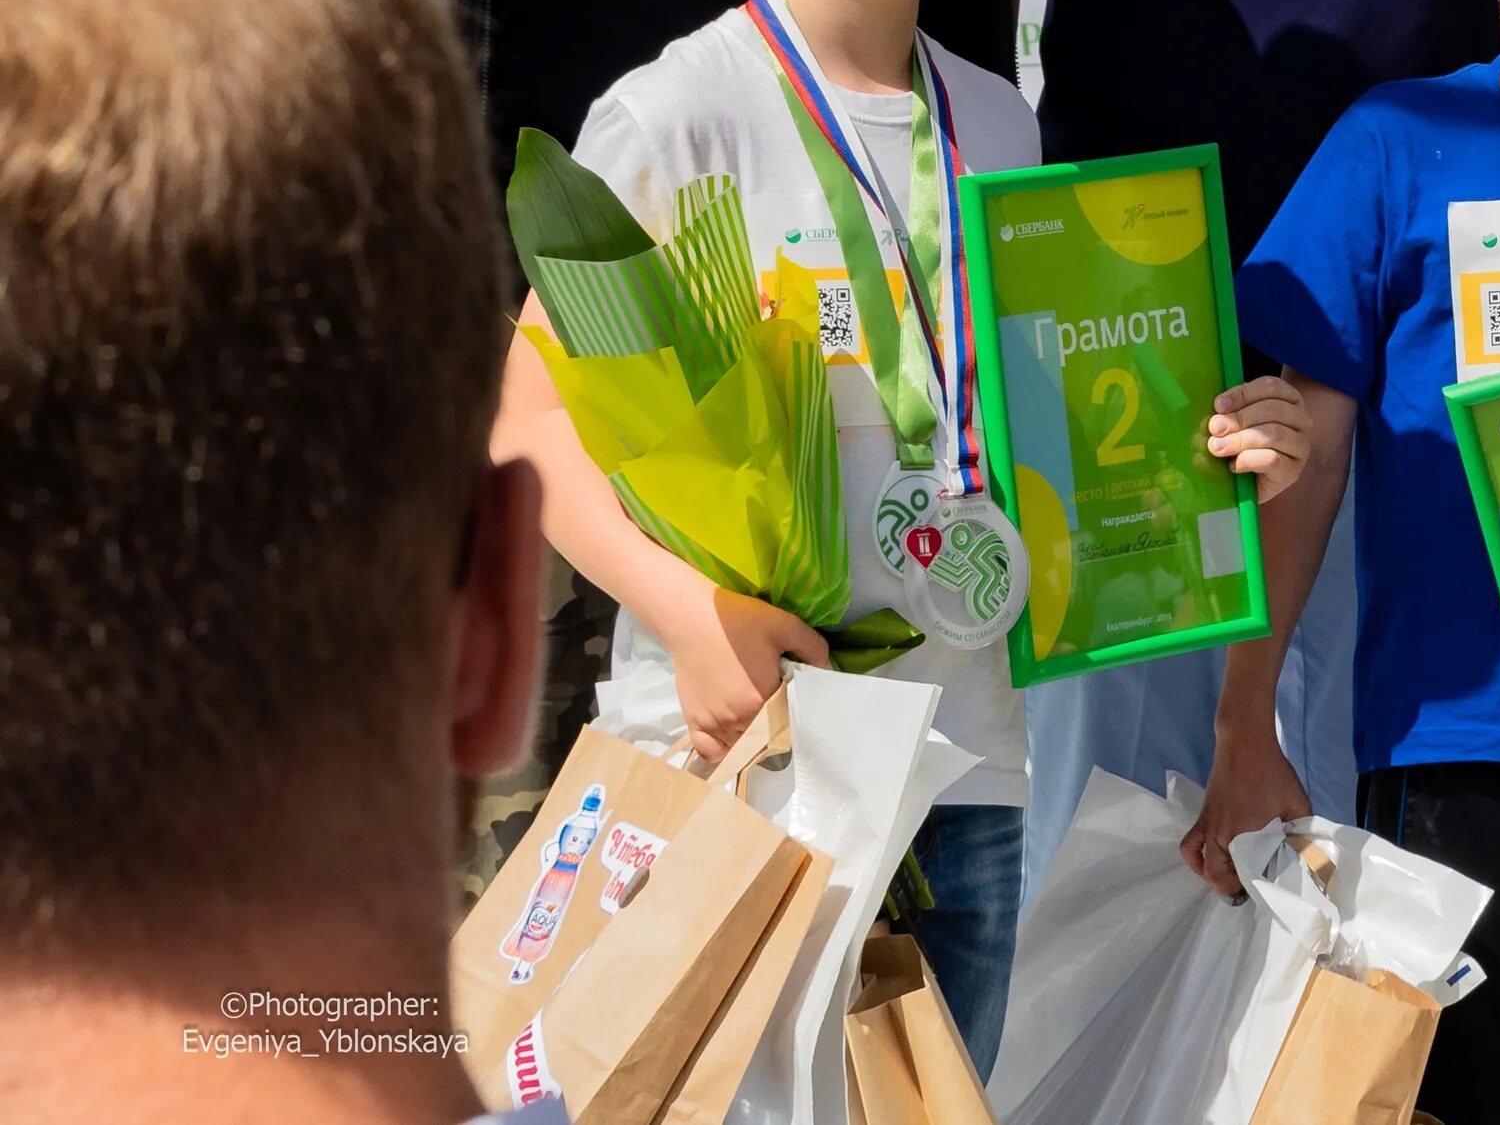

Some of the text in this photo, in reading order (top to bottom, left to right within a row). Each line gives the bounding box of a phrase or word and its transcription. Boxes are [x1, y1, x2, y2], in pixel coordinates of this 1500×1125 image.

[805, 229, 839, 239] СБЕР
[1015, 218, 1065, 236] СБЕРБАНК
[1034, 305, 1190, 368] Грамота
[1091, 368, 1146, 467] 2
